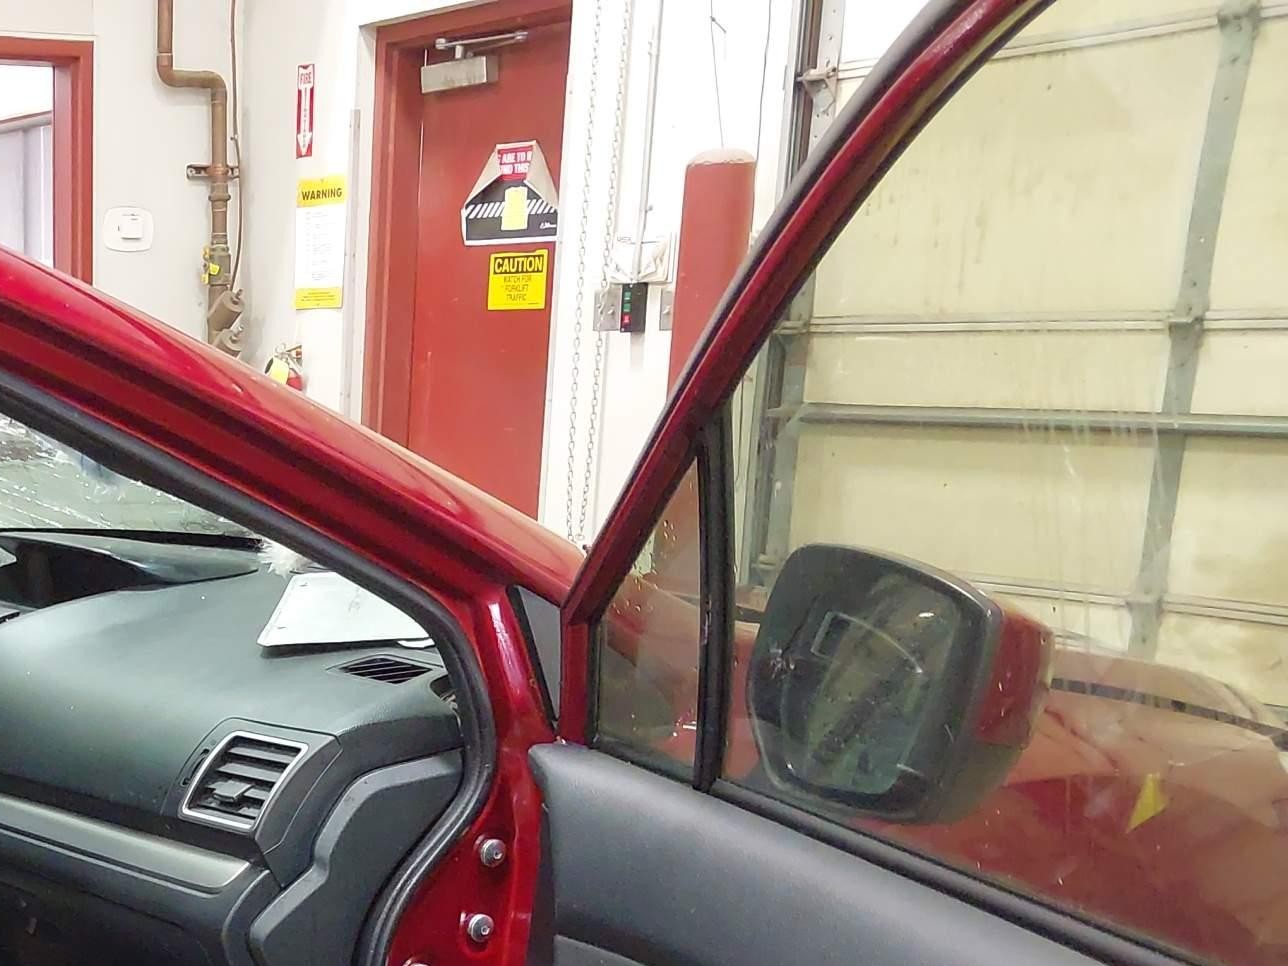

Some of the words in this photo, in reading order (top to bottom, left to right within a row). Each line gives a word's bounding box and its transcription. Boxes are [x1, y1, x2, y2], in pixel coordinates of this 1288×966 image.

[300, 72, 312, 85] FIRE
[516, 152, 526, 162] TO
[301, 187, 343, 201] WARNING
[494, 256, 543, 273] CAUTION
[505, 284, 529, 293] FORKLIFT
[506, 293, 527, 302] TRAFFIC
